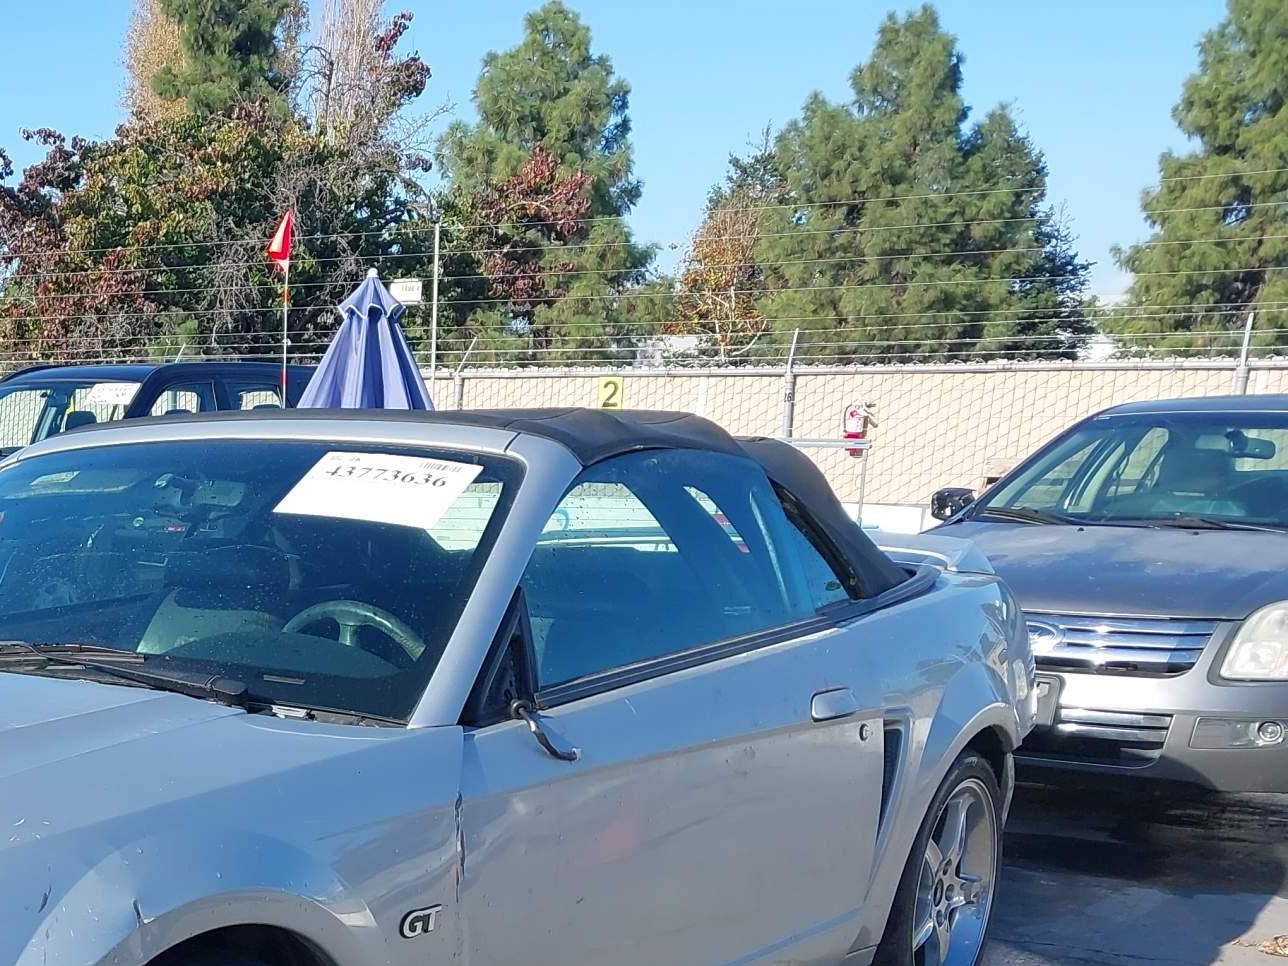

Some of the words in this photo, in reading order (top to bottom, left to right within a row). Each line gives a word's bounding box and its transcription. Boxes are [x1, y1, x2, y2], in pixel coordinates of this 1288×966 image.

[603, 380, 619, 407] 2
[325, 465, 449, 488] 43773636
[399, 903, 442, 939] GT
